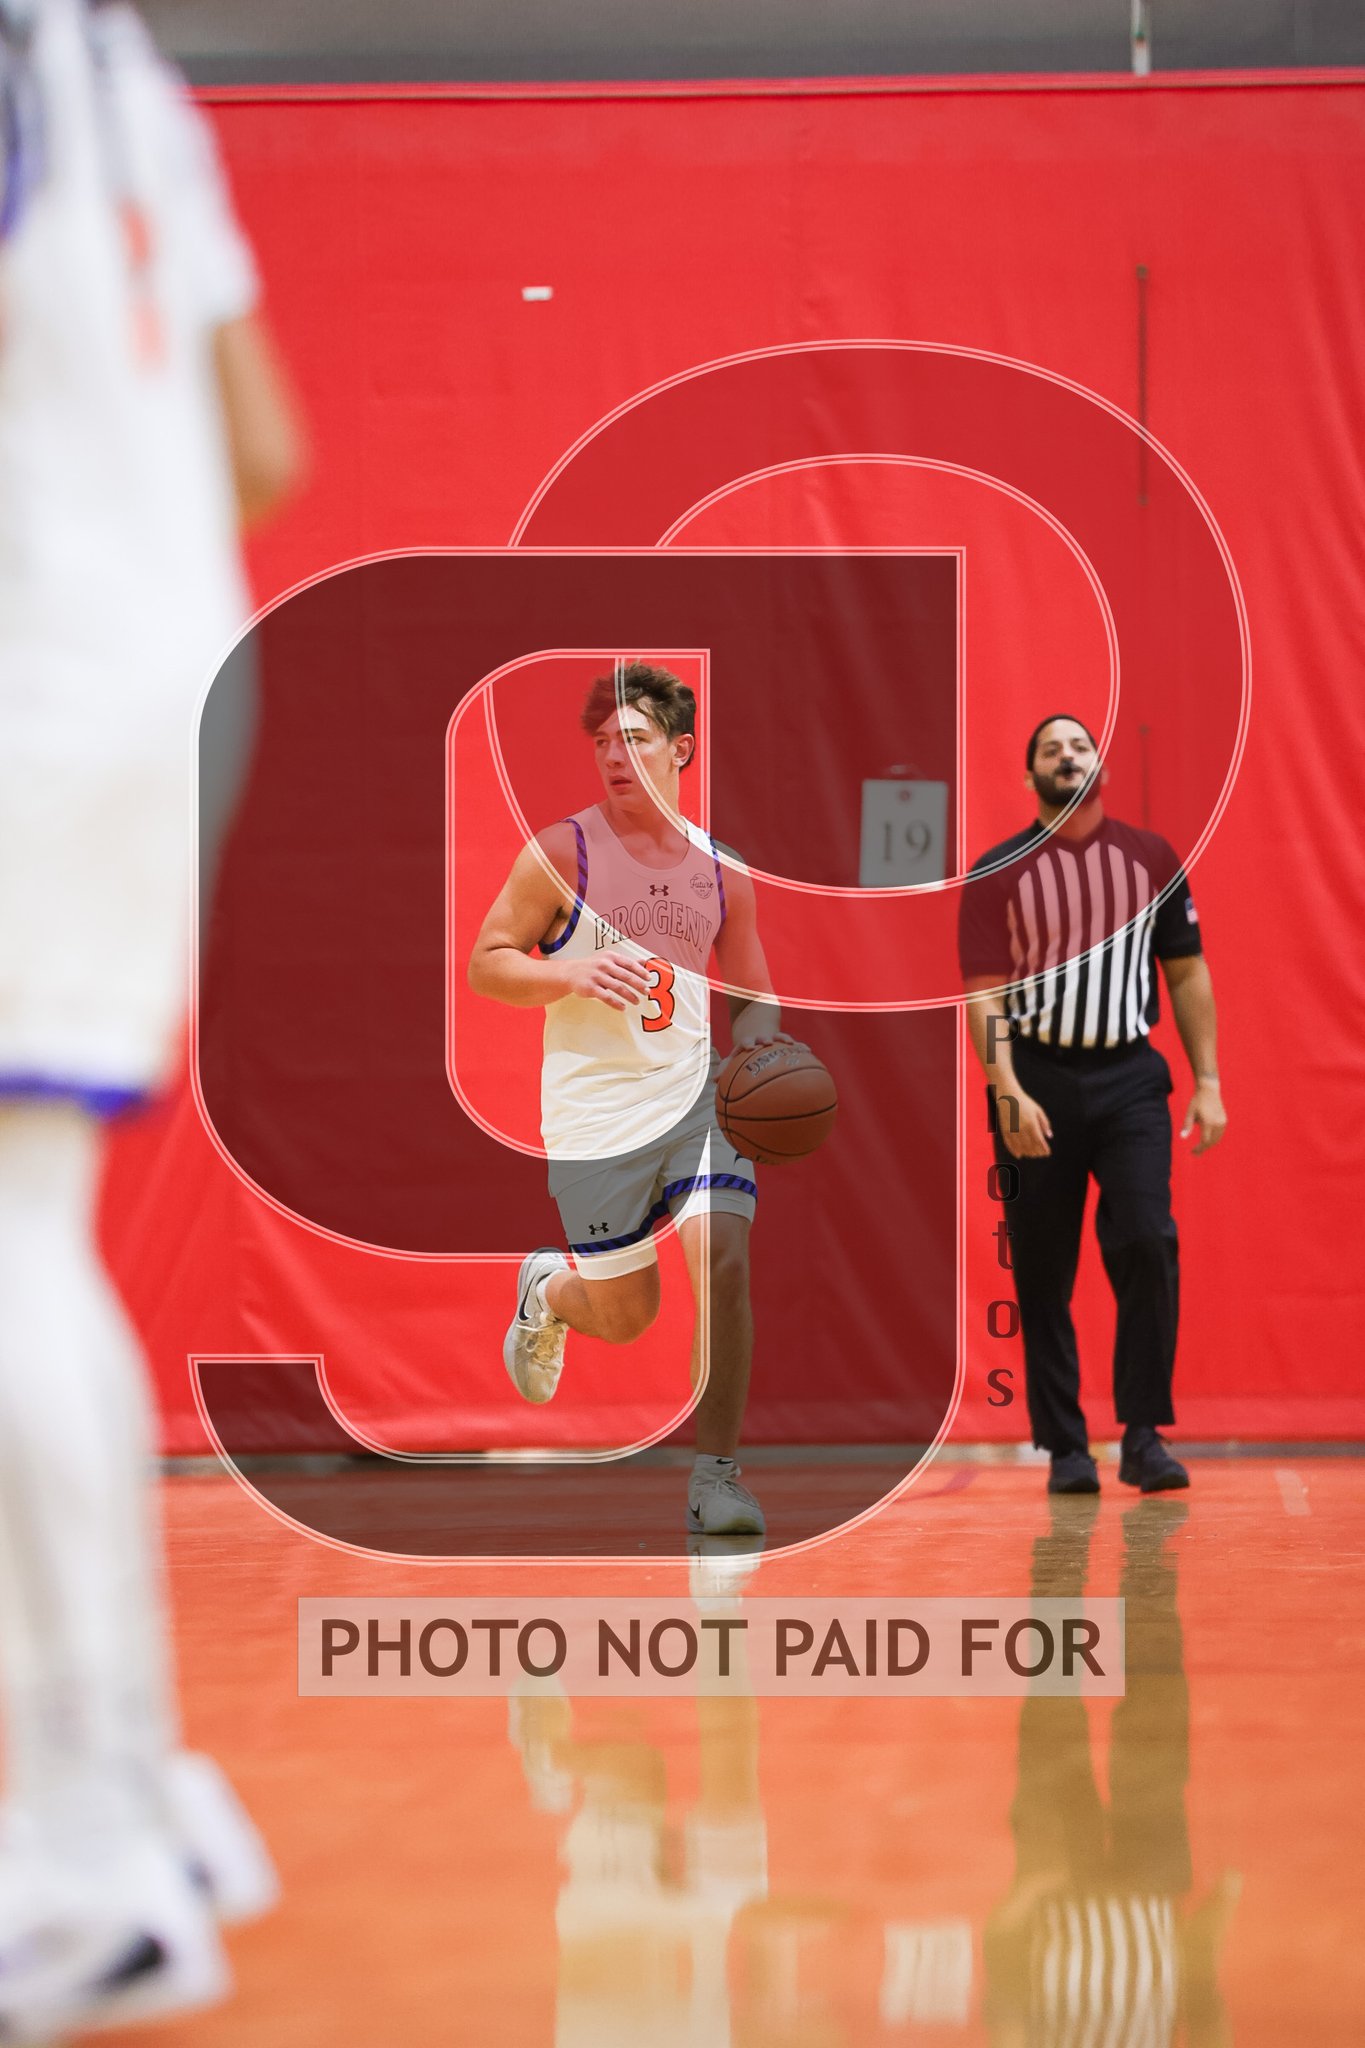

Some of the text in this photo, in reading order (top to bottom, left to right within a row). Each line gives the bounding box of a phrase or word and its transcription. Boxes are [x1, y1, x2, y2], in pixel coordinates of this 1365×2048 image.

[880, 820, 932, 864] 19
[594, 899, 713, 953] PROGENY
[641, 957, 676, 1032] 3
